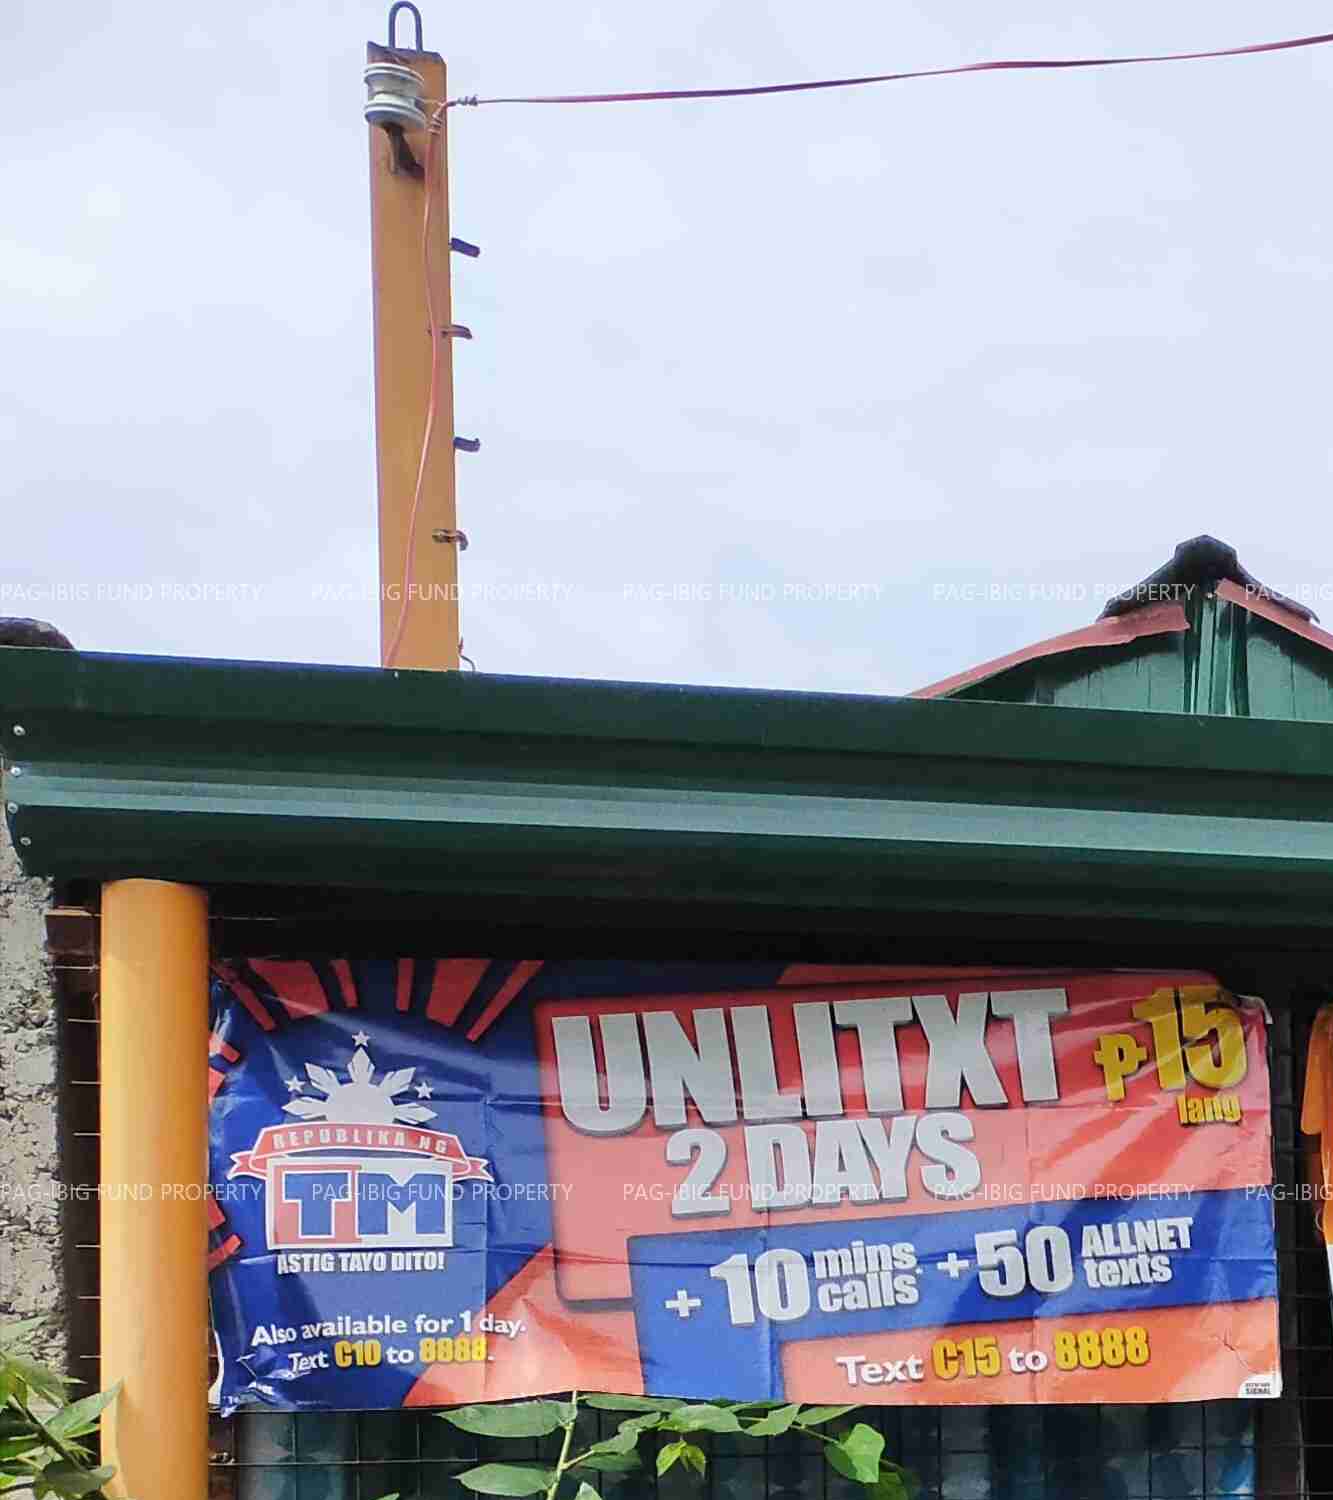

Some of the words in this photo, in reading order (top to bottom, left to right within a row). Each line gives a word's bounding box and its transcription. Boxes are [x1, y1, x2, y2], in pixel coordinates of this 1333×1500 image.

[552, 988, 1069, 1135] UNLITXT
[1177, 1095, 1242, 1125] lang
[272, 1127, 407, 1151] REPUBLIKA
[417, 1134, 448, 1154] NG
[667, 1129, 729, 1218] 2
[744, 1112, 981, 1213] DAYS
[281, 1169, 448, 1240] TM
[1081, 1217, 1193, 1257] ALLNET
[276, 1252, 336, 1275] ASTIG
[337, 1252, 387, 1273] TAYO
[390, 1251, 446, 1272] DITO!
[817, 1268, 919, 1313] calls
[1083, 1252, 1172, 1289] texts
[251, 1323, 296, 1347] Also
[302, 1314, 410, 1339] available
[414, 1314, 450, 1335] for
[458, 1310, 473, 1333] 1
[479, 1314, 527, 1338] day.
[288, 1349, 329, 1373] Text
[334, 1339, 382, 1368] C10
[386, 1345, 415, 1364] to
[835, 1352, 924, 1387] Text
[931, 1336, 1001, 1380] C15
[1008, 1345, 1048, 1374] to
[1053, 1327, 1150, 1371] 8888
